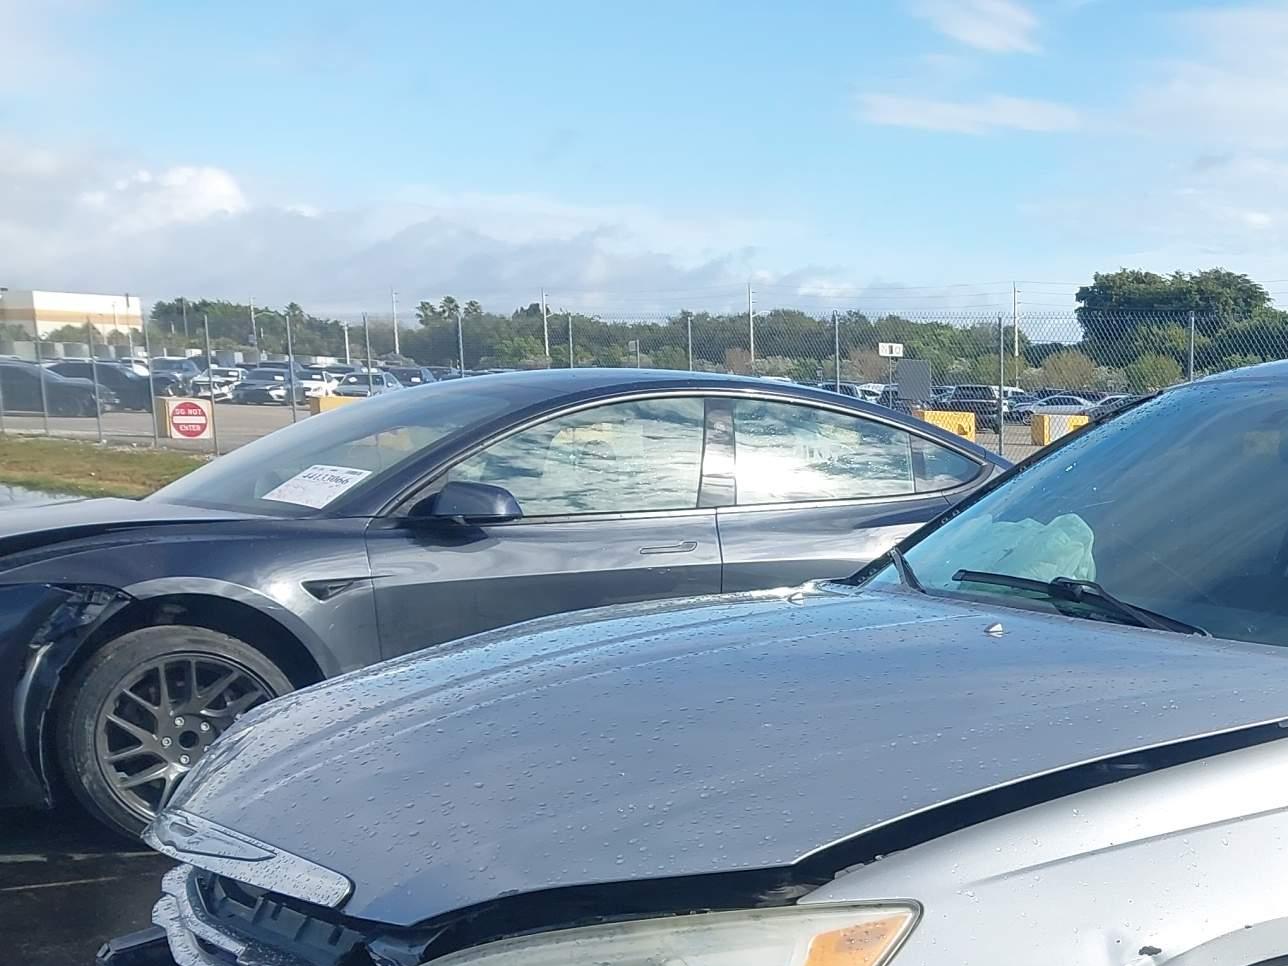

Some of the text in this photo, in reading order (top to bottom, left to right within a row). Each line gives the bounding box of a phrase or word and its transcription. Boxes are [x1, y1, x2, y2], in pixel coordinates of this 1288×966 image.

[175, 408, 202, 416] DO NOT
[179, 424, 201, 432] ENTER
